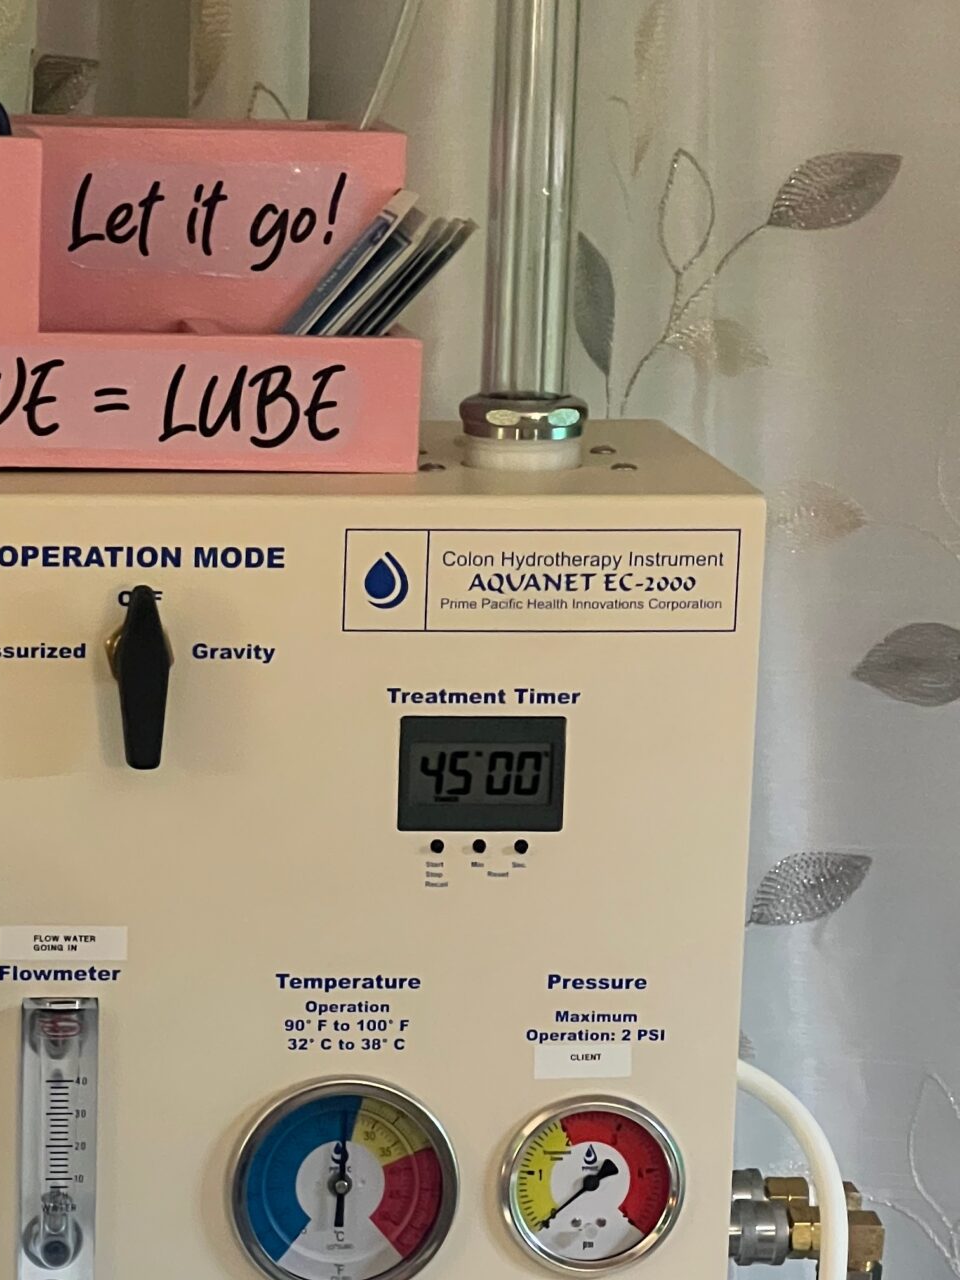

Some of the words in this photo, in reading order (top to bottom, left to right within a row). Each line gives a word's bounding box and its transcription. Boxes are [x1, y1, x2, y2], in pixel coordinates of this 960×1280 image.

[67, 172, 163, 257] Let
[187, 180, 227, 255] it
[249, 172, 348, 272] go!
[158, 363, 346, 448] LUBE
[193, 546, 286, 569] MODE
[442, 550, 495, 567] Colon
[501, 551, 623, 571] Hydrotherapy
[628, 550, 725, 568] Instrument
[467, 573, 597, 594] AQUANET
[603, 574, 697, 592] EC-2000
[117, 590, 163, 607] OF
[440, 598, 478, 610] Prime
[481, 597, 524, 610] Pacific
[527, 597, 568, 610] Health
[572, 597, 645, 610] Innovations
[648, 597, 723, 612] Corporation
[191, 642, 276, 664] Gravity
[387, 688, 507, 704] Treatment
[514, 688, 581, 704] Timer
[33, 935, 60, 943] FLOW
[63, 935, 96, 943] WATER
[33, 944, 64, 952] GOING
[67, 944, 78, 952] IN
[275, 974, 421, 992] Temperature
[547, 974, 648, 990] Pressure
[305, 1000, 390, 1015] Operation
[555, 1010, 638, 1023] Maximum
[317, 1019, 327, 1031] F
[333, 1020, 350, 1032] to
[399, 1019, 410, 1031] F
[526, 1029, 616, 1044] Operation:
[621, 1029, 631, 1041] 2
[637, 1029, 665, 1041] PSI
[320, 1038, 332, 1051] C
[338, 1039, 355, 1051] to
[393, 1038, 405, 1051] C
[570, 1053, 602, 1061] CLIENT
[74, 1141, 87, 1151] 20
[74, 1174, 85, 1184] 10
